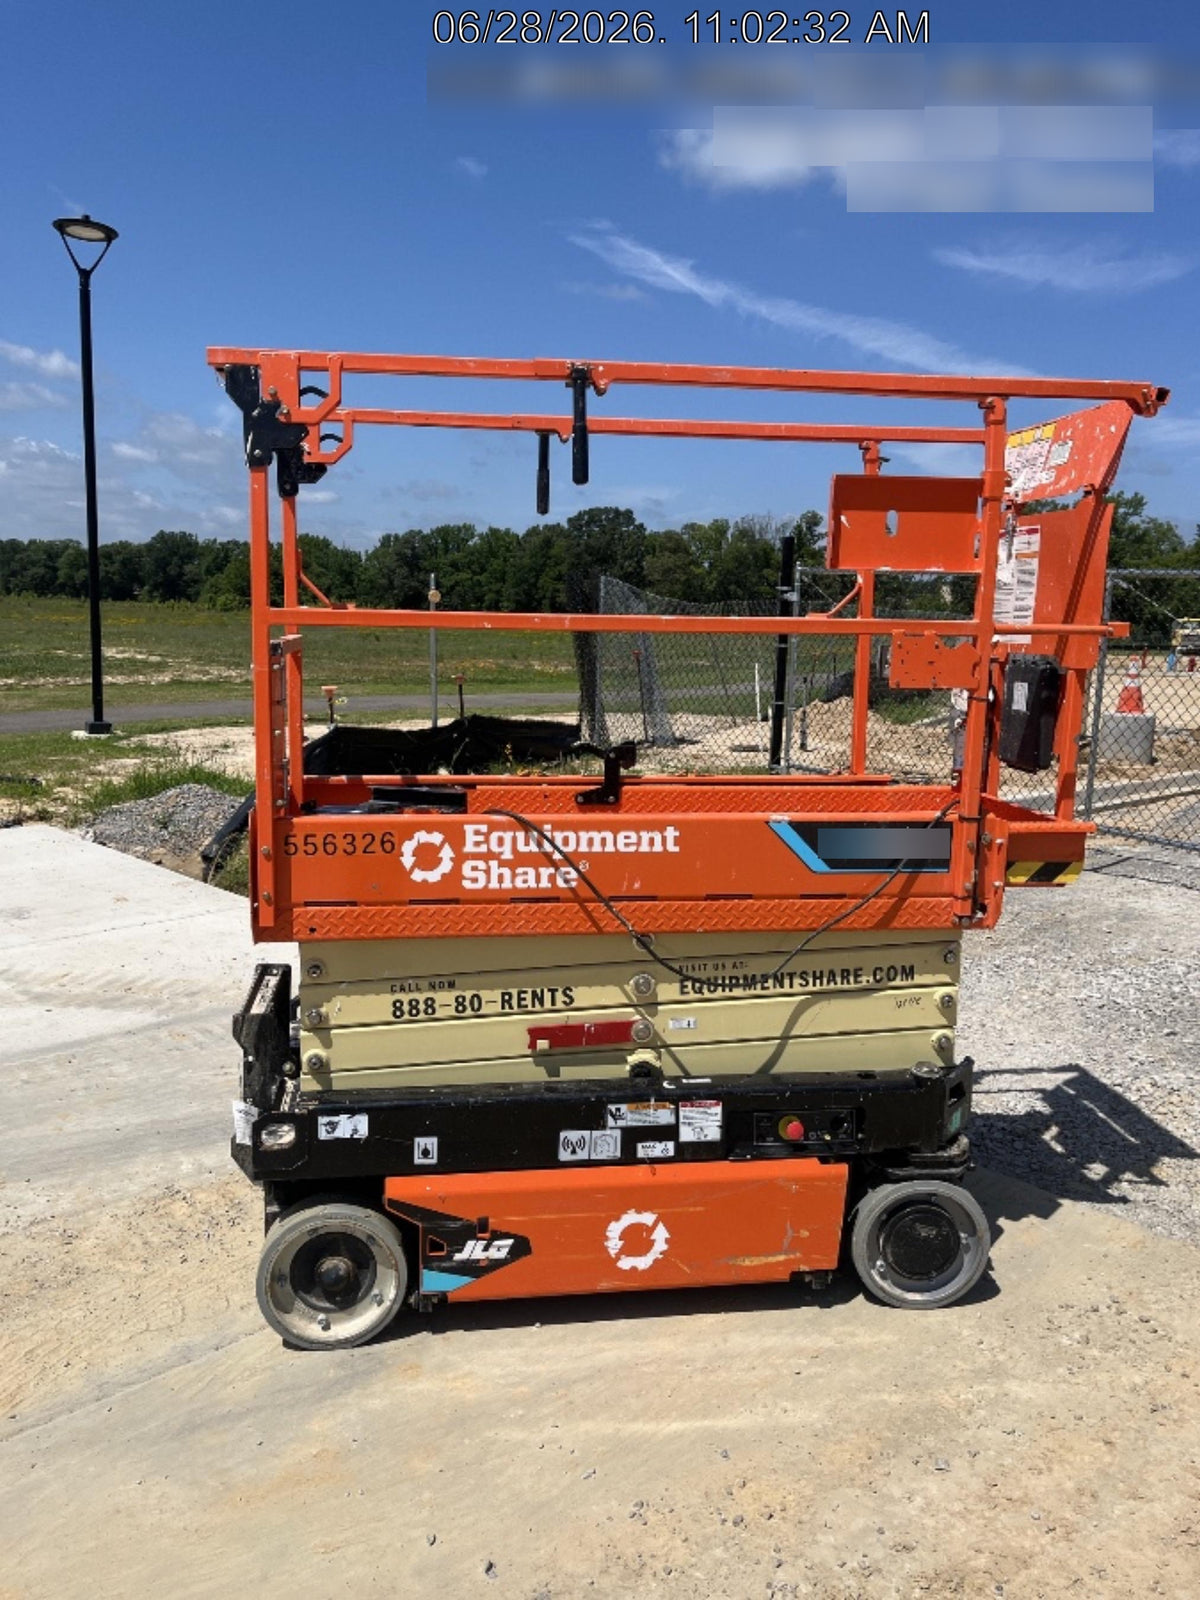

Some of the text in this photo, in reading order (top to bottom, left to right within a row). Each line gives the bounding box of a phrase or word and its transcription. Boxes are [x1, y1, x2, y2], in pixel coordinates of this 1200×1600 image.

[283, 831, 396, 857] 556326
[462, 823, 680, 860] Equipment
[678, 963, 709, 973] VISIT
[712, 962, 727, 971] US
[679, 964, 916, 996] EQUIPMENTSHARE.COM
[390, 980, 456, 993] CALL NOW
[391, 986, 576, 1019] 888-80-RENTS
[453, 1239, 515, 1261] JLG
